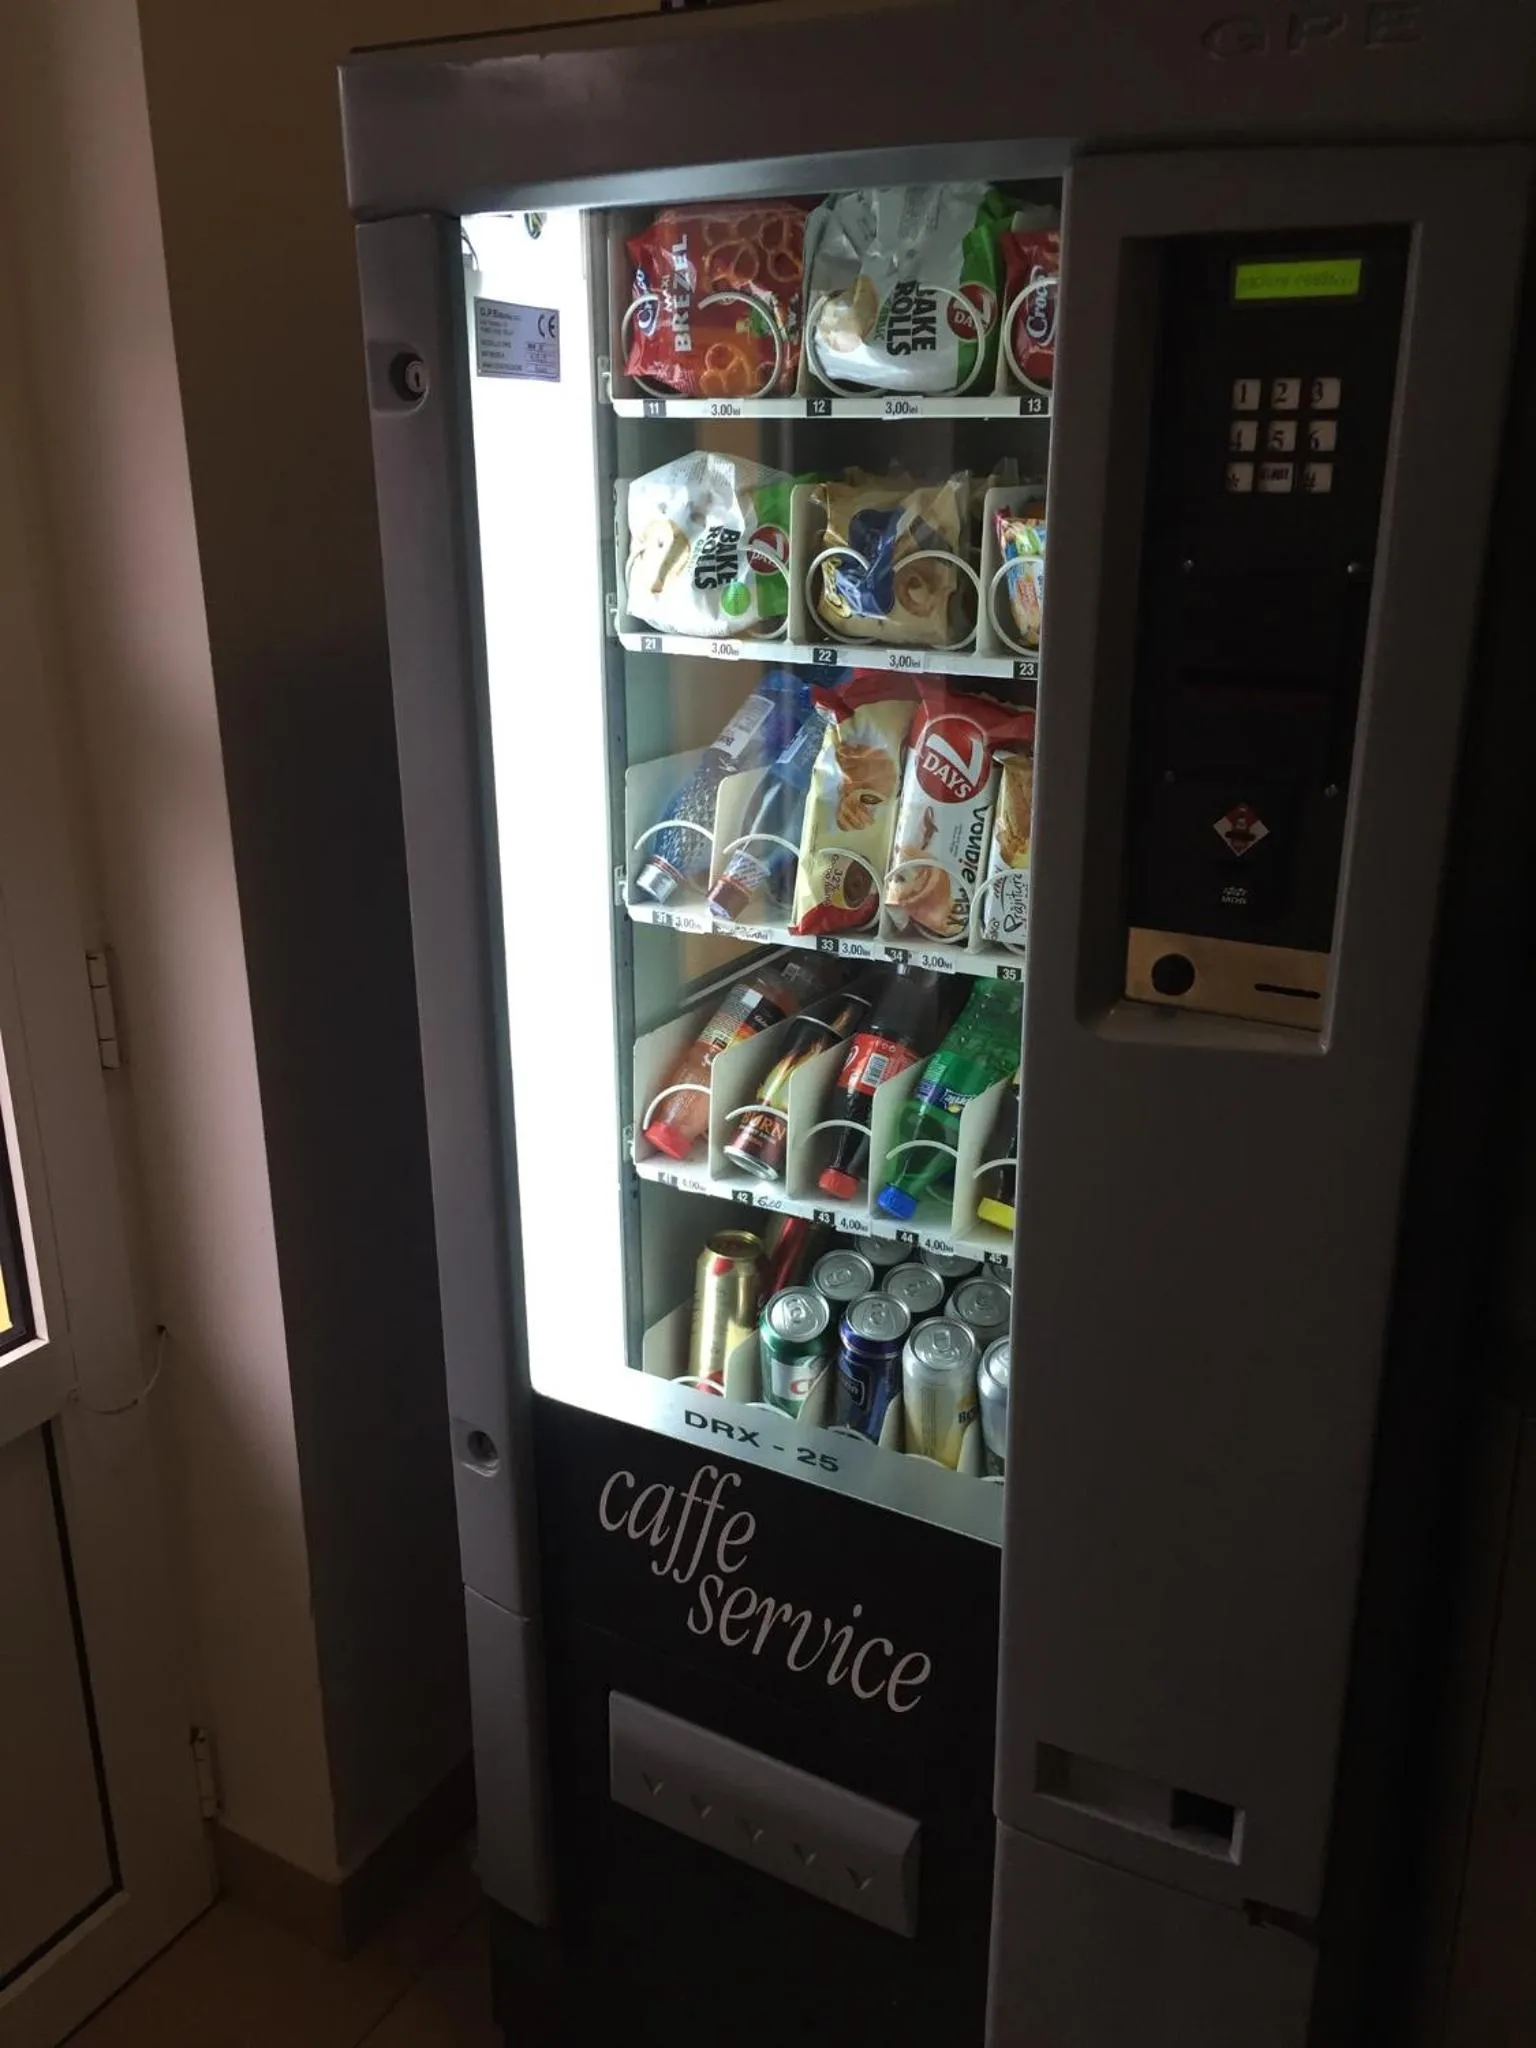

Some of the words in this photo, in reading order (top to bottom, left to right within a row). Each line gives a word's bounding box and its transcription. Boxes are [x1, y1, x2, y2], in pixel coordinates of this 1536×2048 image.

[672, 234, 692, 352] BREZEL
[886, 280, 917, 356] ROLLS
[648, 402, 660, 415] 11
[812, 400, 826, 414] 12
[1027, 398, 1042, 413] 13
[694, 525, 725, 589] ROLLS
[716, 527, 742, 585] BAKE
[644, 638, 657, 650] 21
[818, 650, 832, 663] 22
[1018, 663, 1035, 677] 23
[926, 733, 984, 788] 7
[922, 751, 972, 798] DAYS
[821, 938, 834, 951] 33
[1002, 968, 1017, 981] 35
[736, 1190, 749, 1203] 42
[818, 1212, 831, 1224] 43
[899, 1231, 914, 1244] 44
[684, 1410, 761, 1448] DRX
[797, 1447, 839, 1473] 25
[599, 1464, 757, 1584] caffe
[686, 1573, 932, 1713] service
